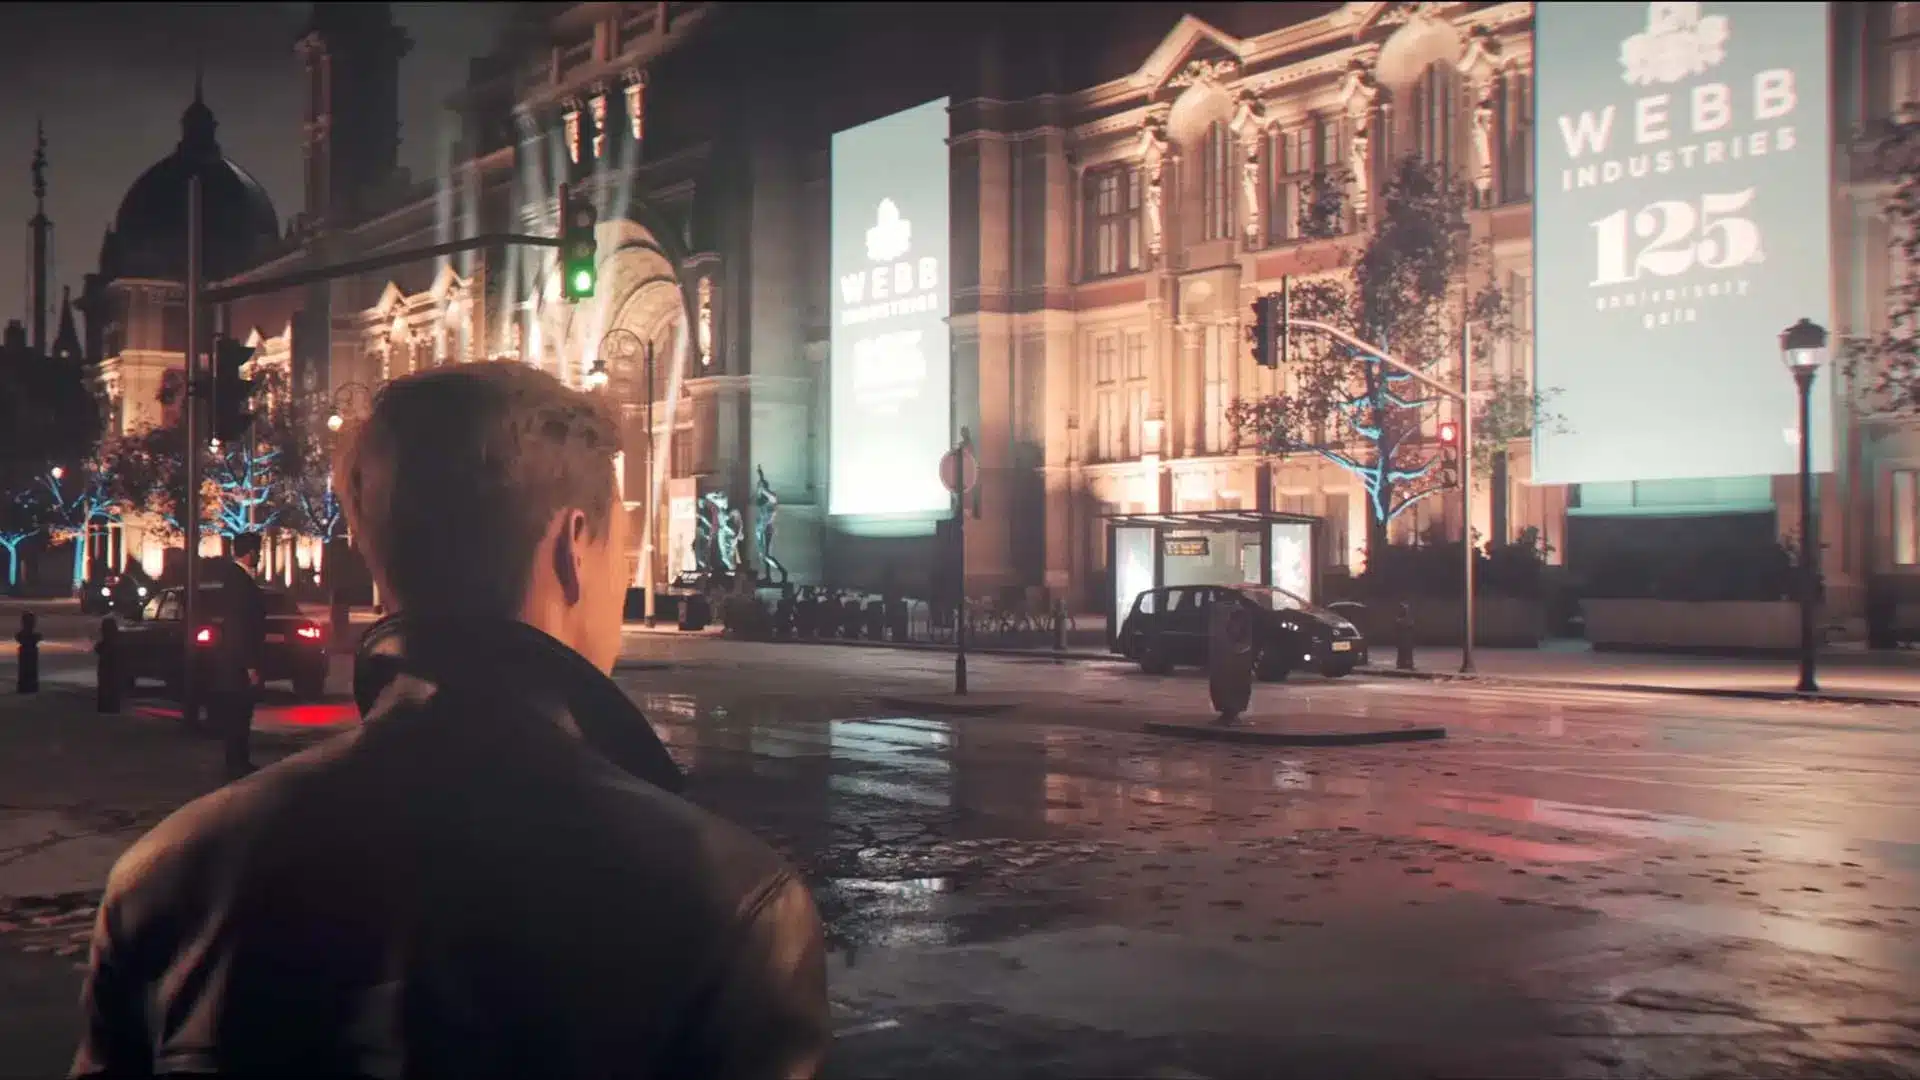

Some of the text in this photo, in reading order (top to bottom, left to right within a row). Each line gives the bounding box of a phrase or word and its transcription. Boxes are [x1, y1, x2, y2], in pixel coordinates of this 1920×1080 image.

[1557, 67, 1798, 159] WEBB
[1561, 126, 1798, 192] INDUSTRIES
[1588, 186, 1761, 287] 125
[840, 256, 937, 304] WEBB
